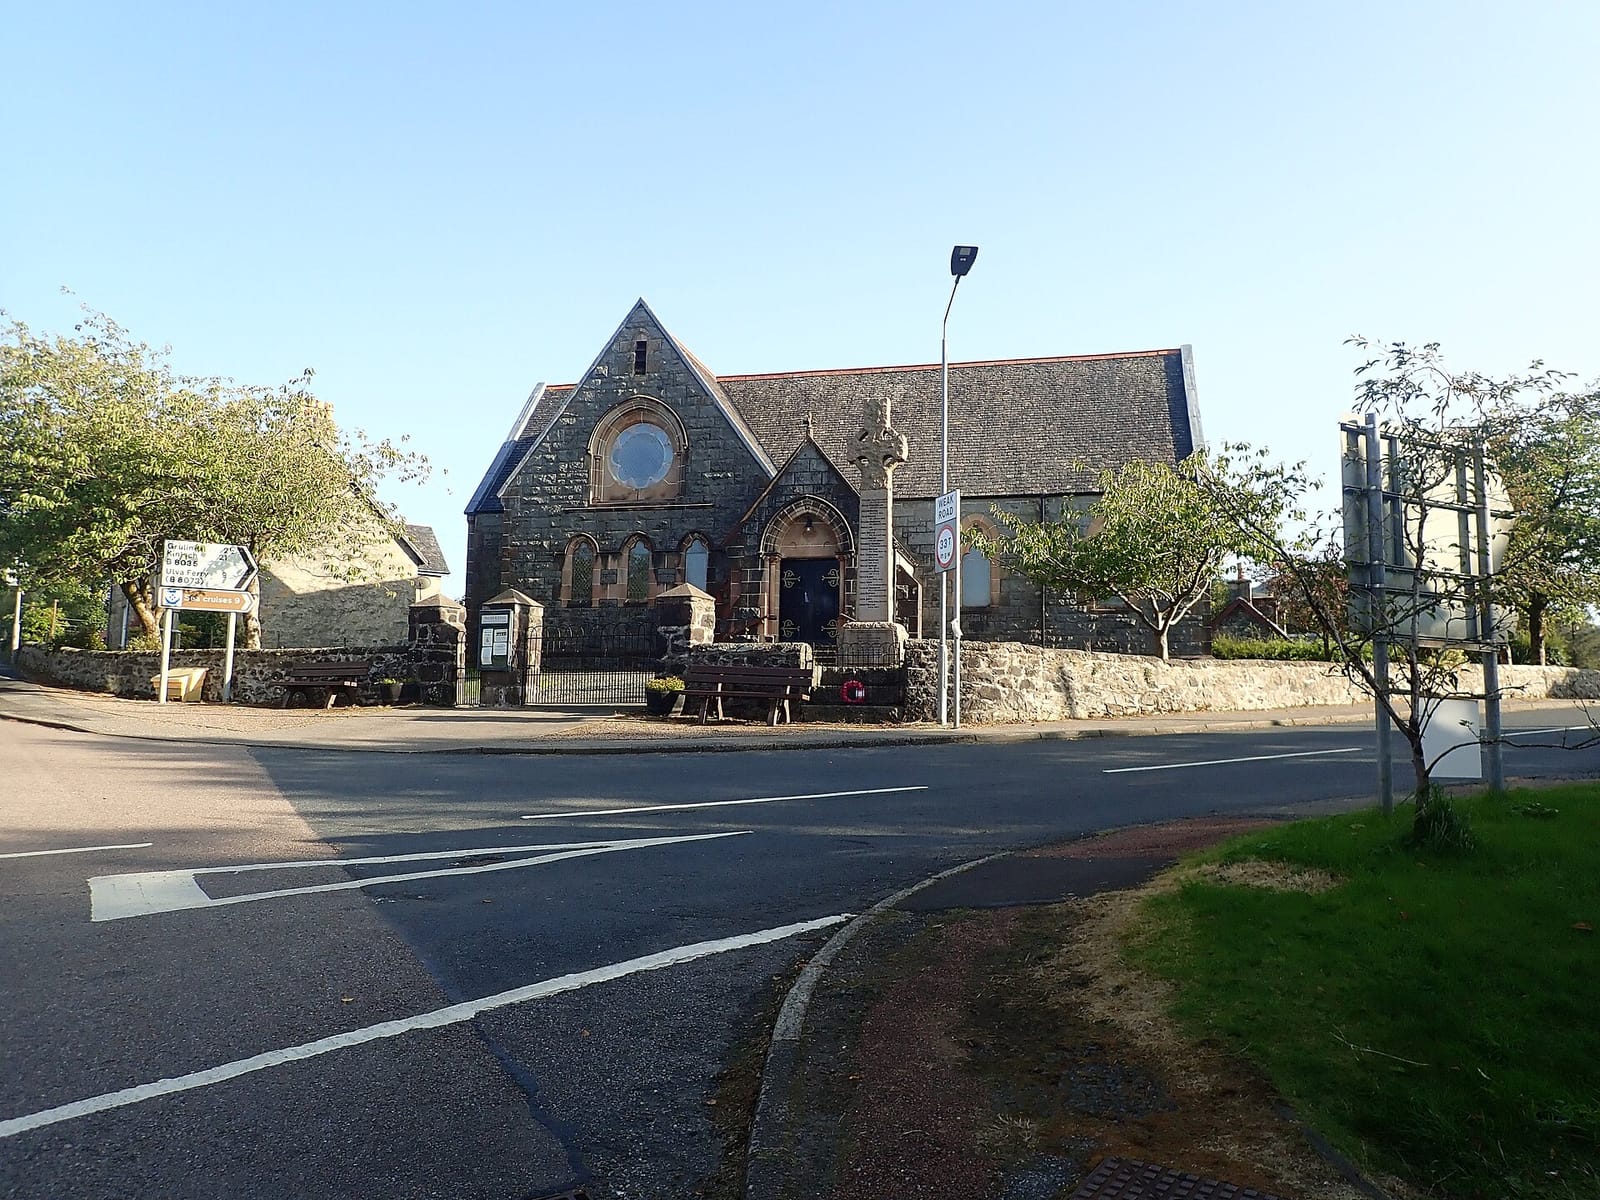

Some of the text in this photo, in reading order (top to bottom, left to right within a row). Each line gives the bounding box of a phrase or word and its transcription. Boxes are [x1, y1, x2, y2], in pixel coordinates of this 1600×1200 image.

[938, 494, 954, 507] WEAK
[938, 506, 954, 520] ROAD
[167, 542, 205, 551] Grulin
[940, 537, 951, 550] 33T
[174, 559, 199, 567] 8035
[165, 568, 209, 578] Ulva Ferry
[177, 576, 204, 586] 8073)
[202, 595, 233, 604] cruises
